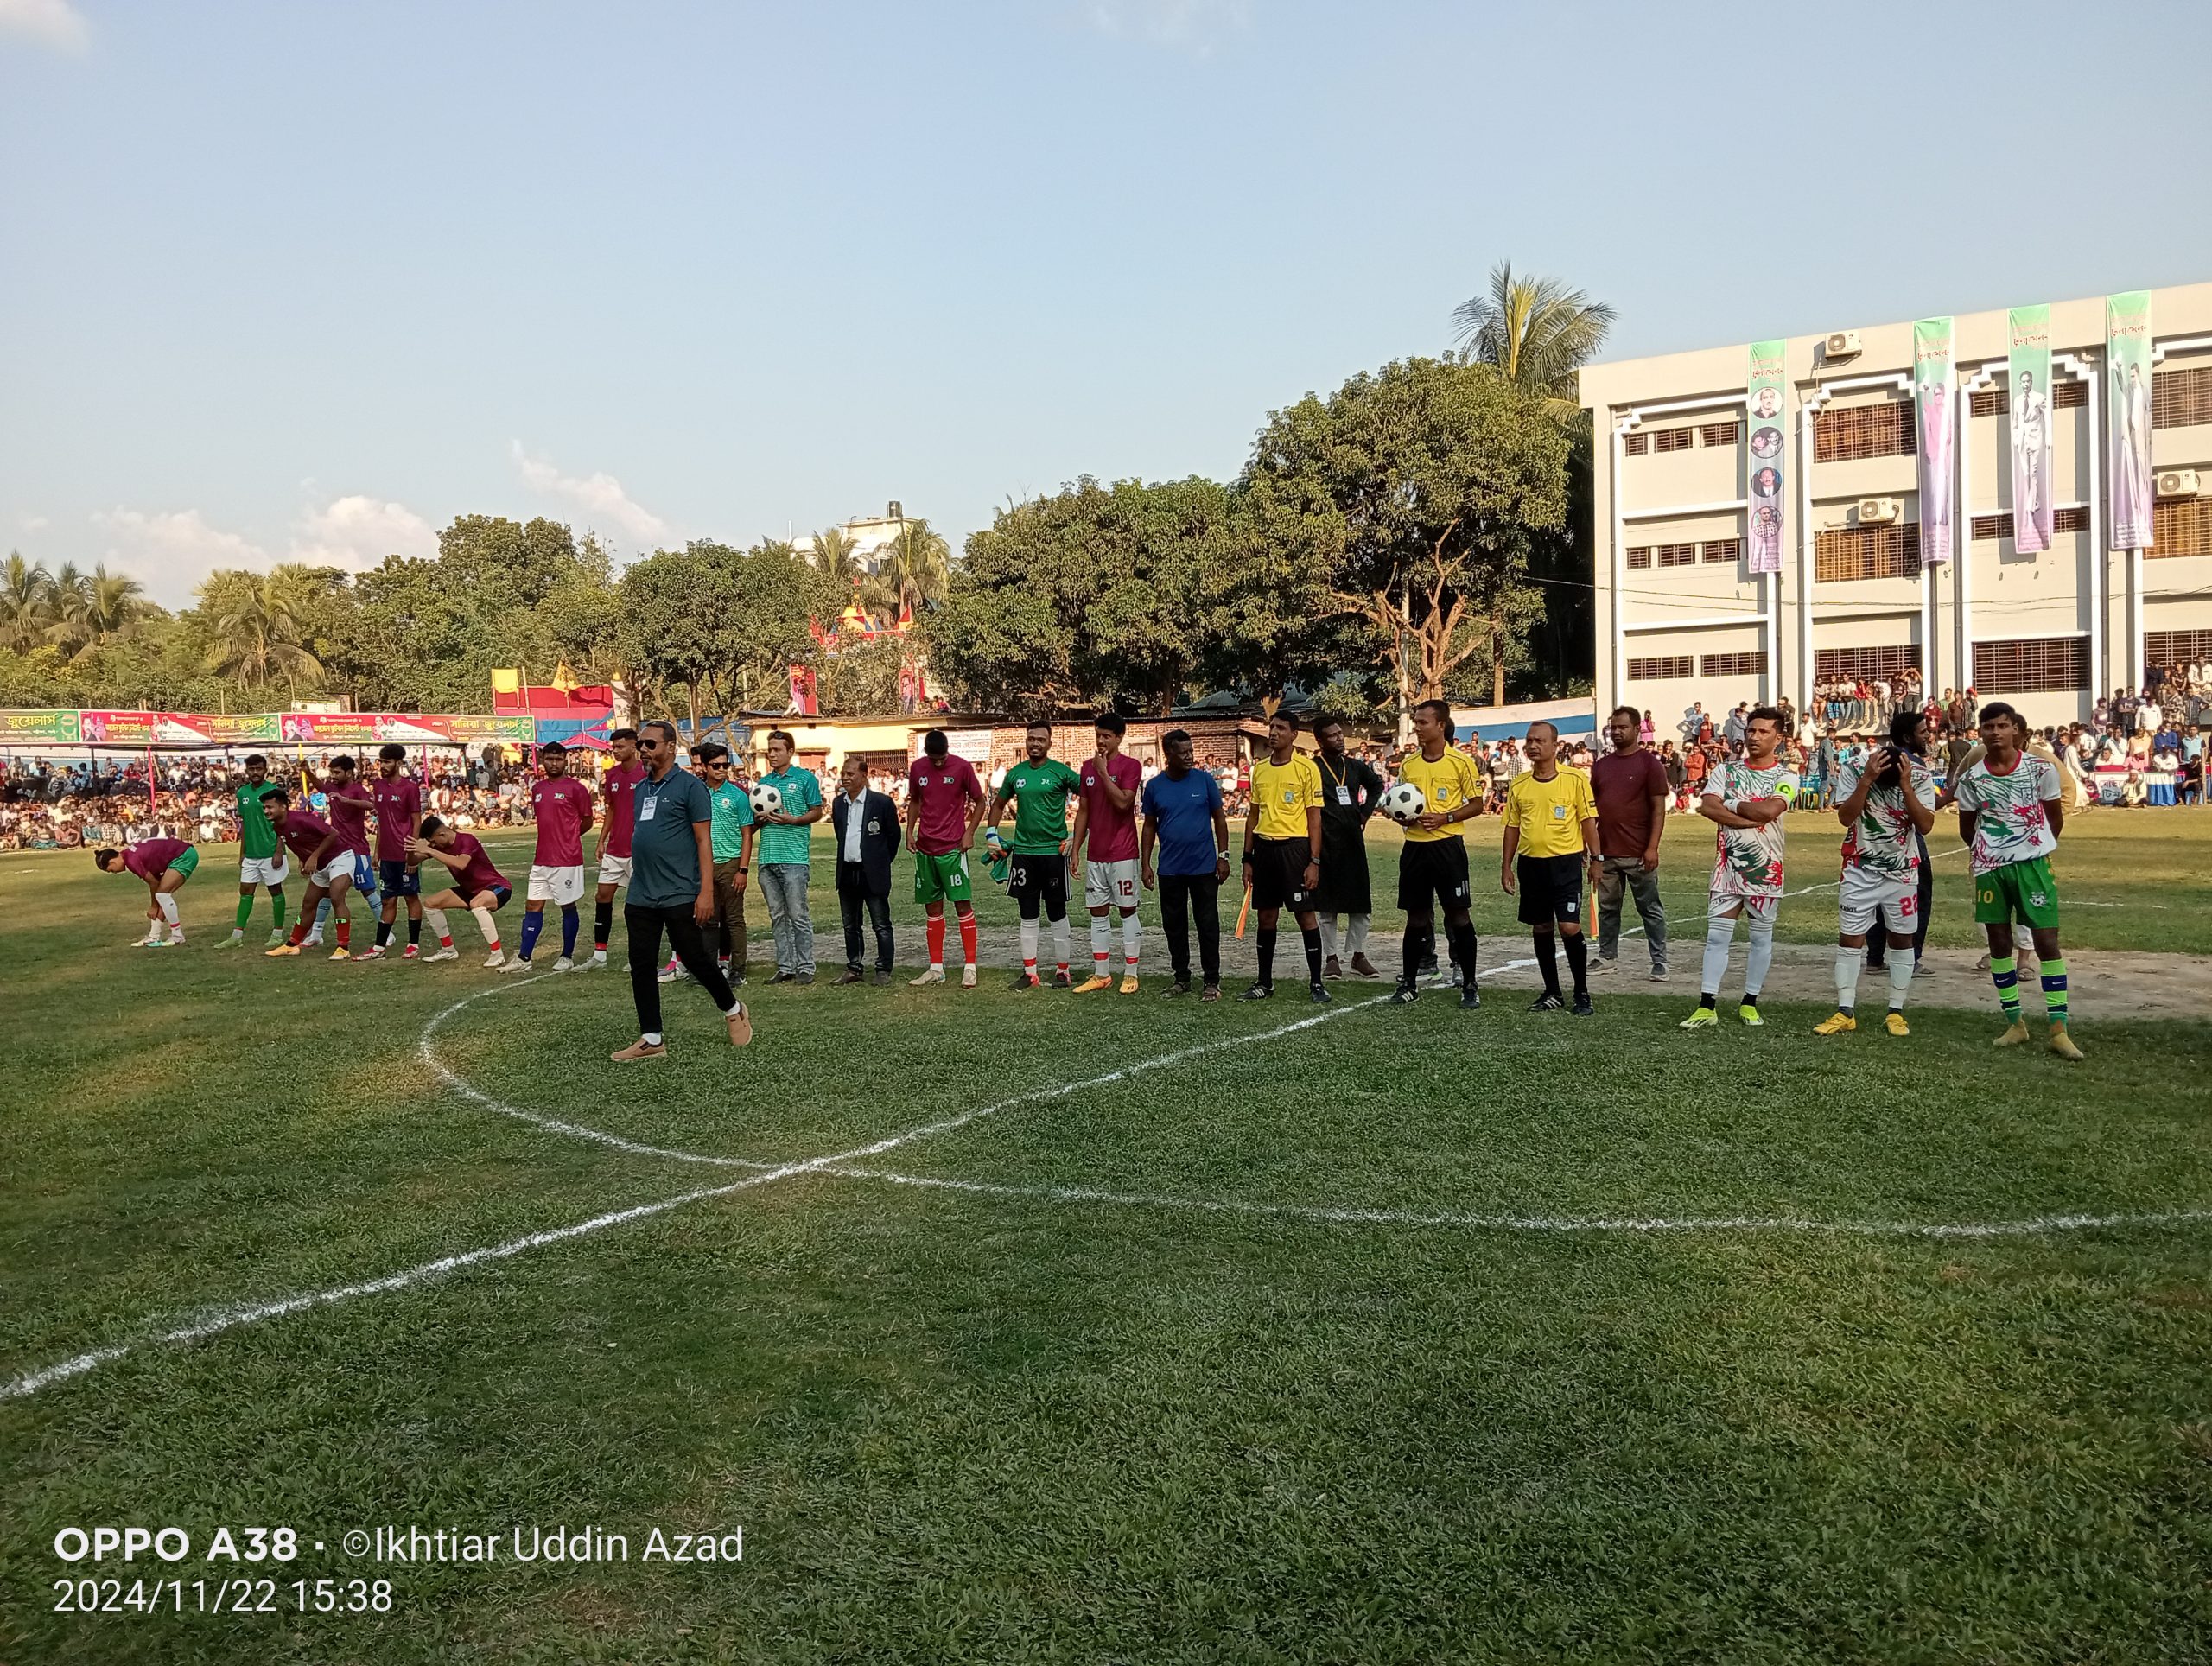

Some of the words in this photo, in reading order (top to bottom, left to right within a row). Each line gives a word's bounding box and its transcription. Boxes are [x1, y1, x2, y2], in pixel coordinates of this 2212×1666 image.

[3, 713, 58, 729] জুয়েলার্স
[450, 717, 480, 728] সানিয়া
[1779, 785, 1791, 794] C
[2101, 788, 2121, 798] টিম
[356, 874, 366, 884] 21
[950, 874, 962, 887] 18
[1117, 880, 1133, 896] 12
[1976, 889, 1993, 905] 10
